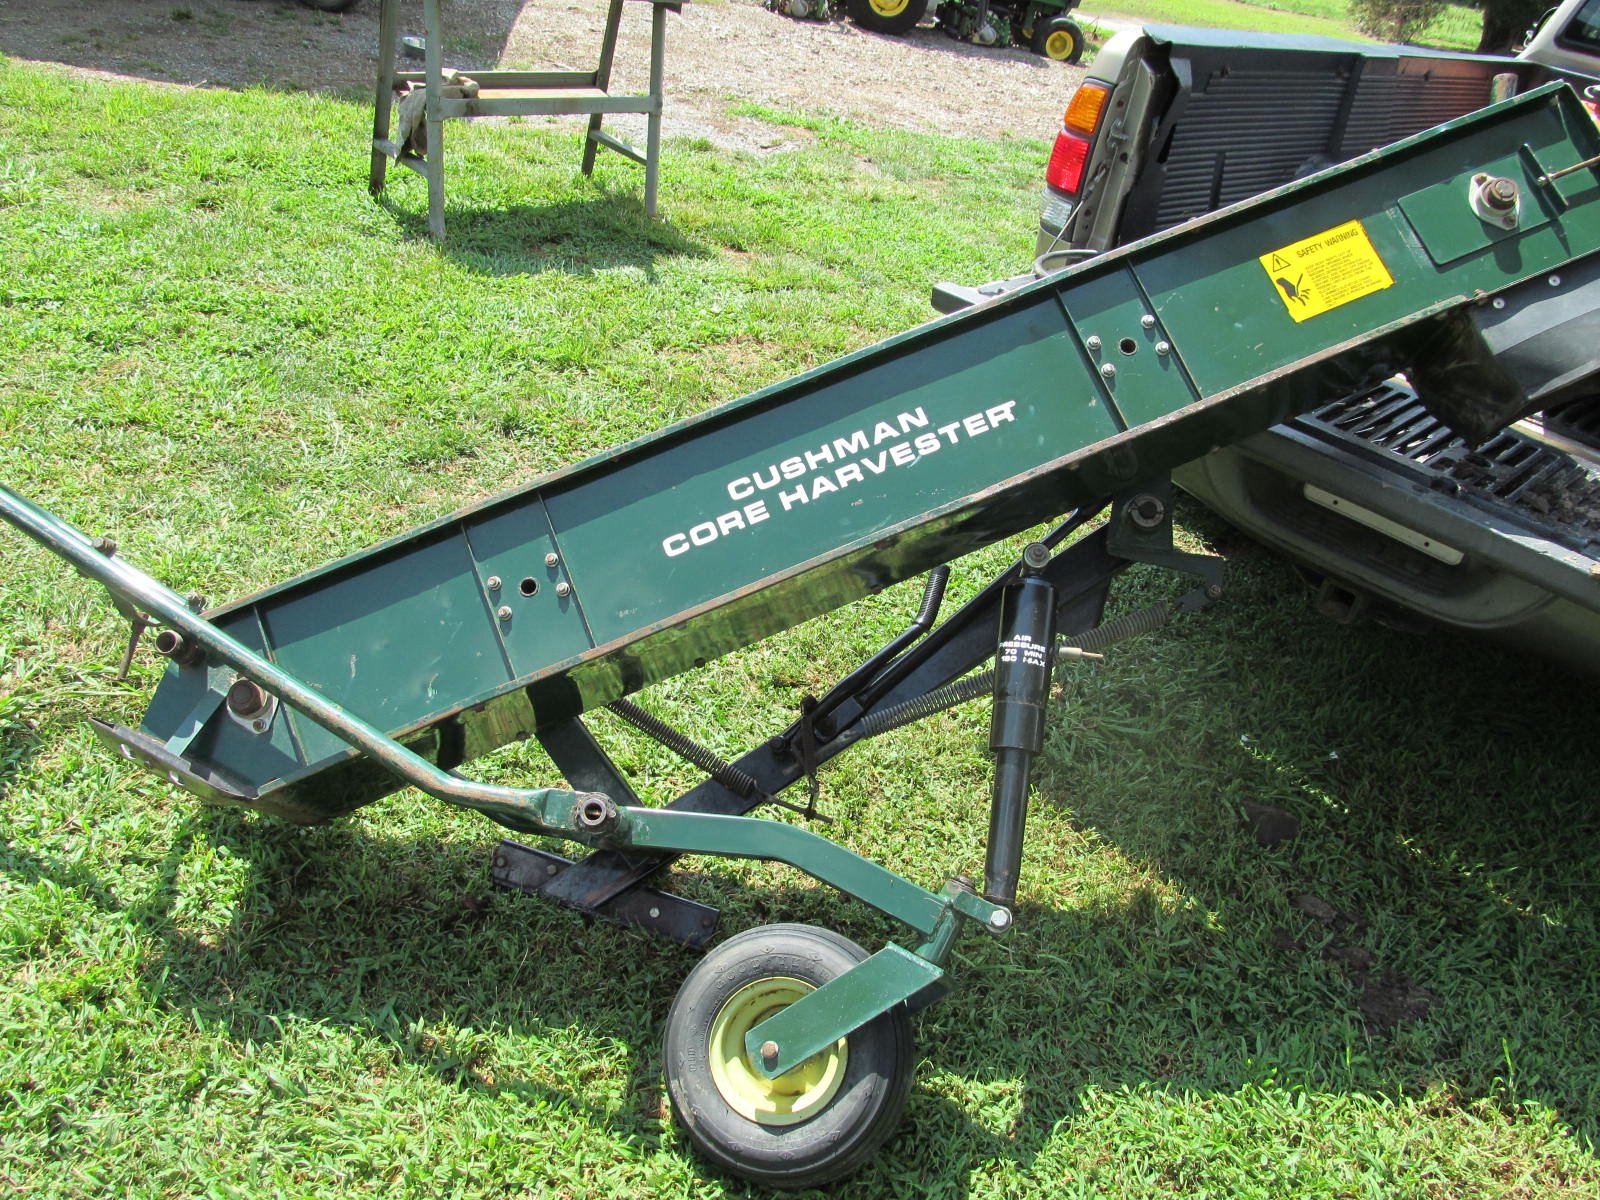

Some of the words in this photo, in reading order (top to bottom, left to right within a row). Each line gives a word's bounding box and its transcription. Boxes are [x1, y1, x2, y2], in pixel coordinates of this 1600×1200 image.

[1296, 242, 1323, 258] SAFETY
[1324, 228, 1359, 247] WARNING
[727, 406, 930, 501] CUSHMAN
[662, 499, 770, 557] CORE
[778, 400, 1016, 511] HARVESTER
[1013, 634, 1032, 642] AIR
[1022, 657, 1046, 667] MAX
[1024, 650, 1043, 659] MIN
